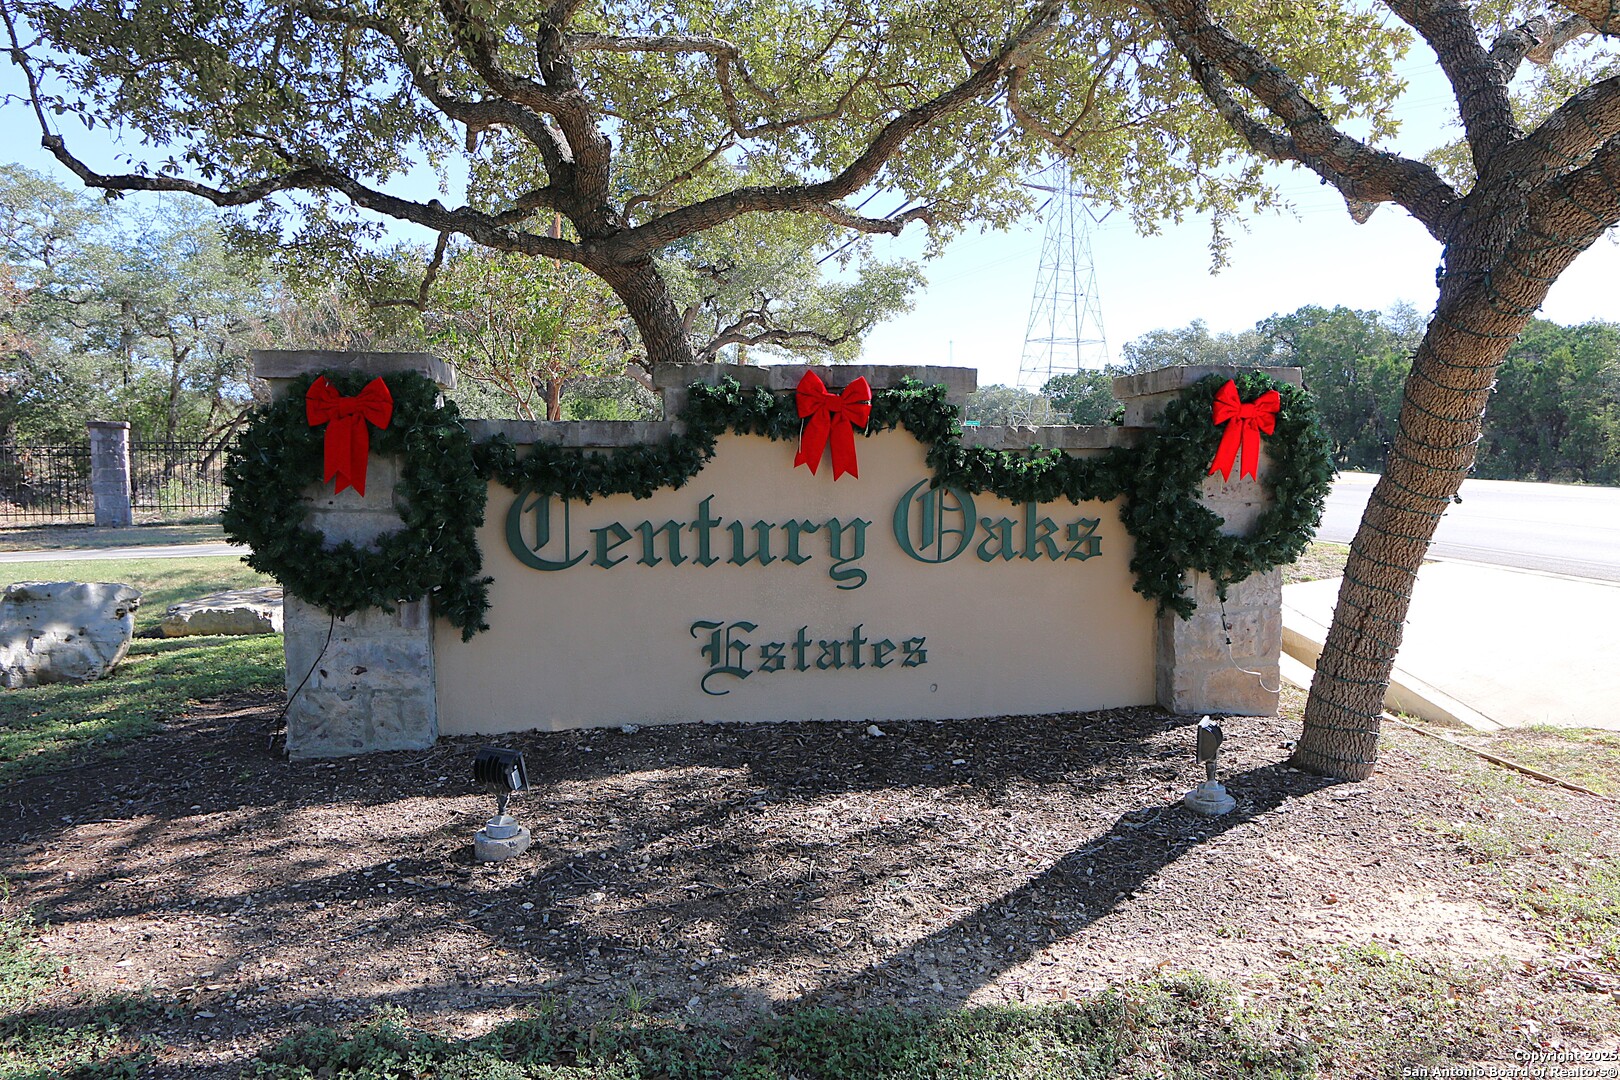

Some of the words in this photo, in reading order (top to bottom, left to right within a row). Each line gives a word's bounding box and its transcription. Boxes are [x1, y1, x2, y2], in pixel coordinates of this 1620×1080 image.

[506, 486, 873, 590] Century
[892, 478, 1103, 564] Oaks
[690, 620, 928, 696] Estates
